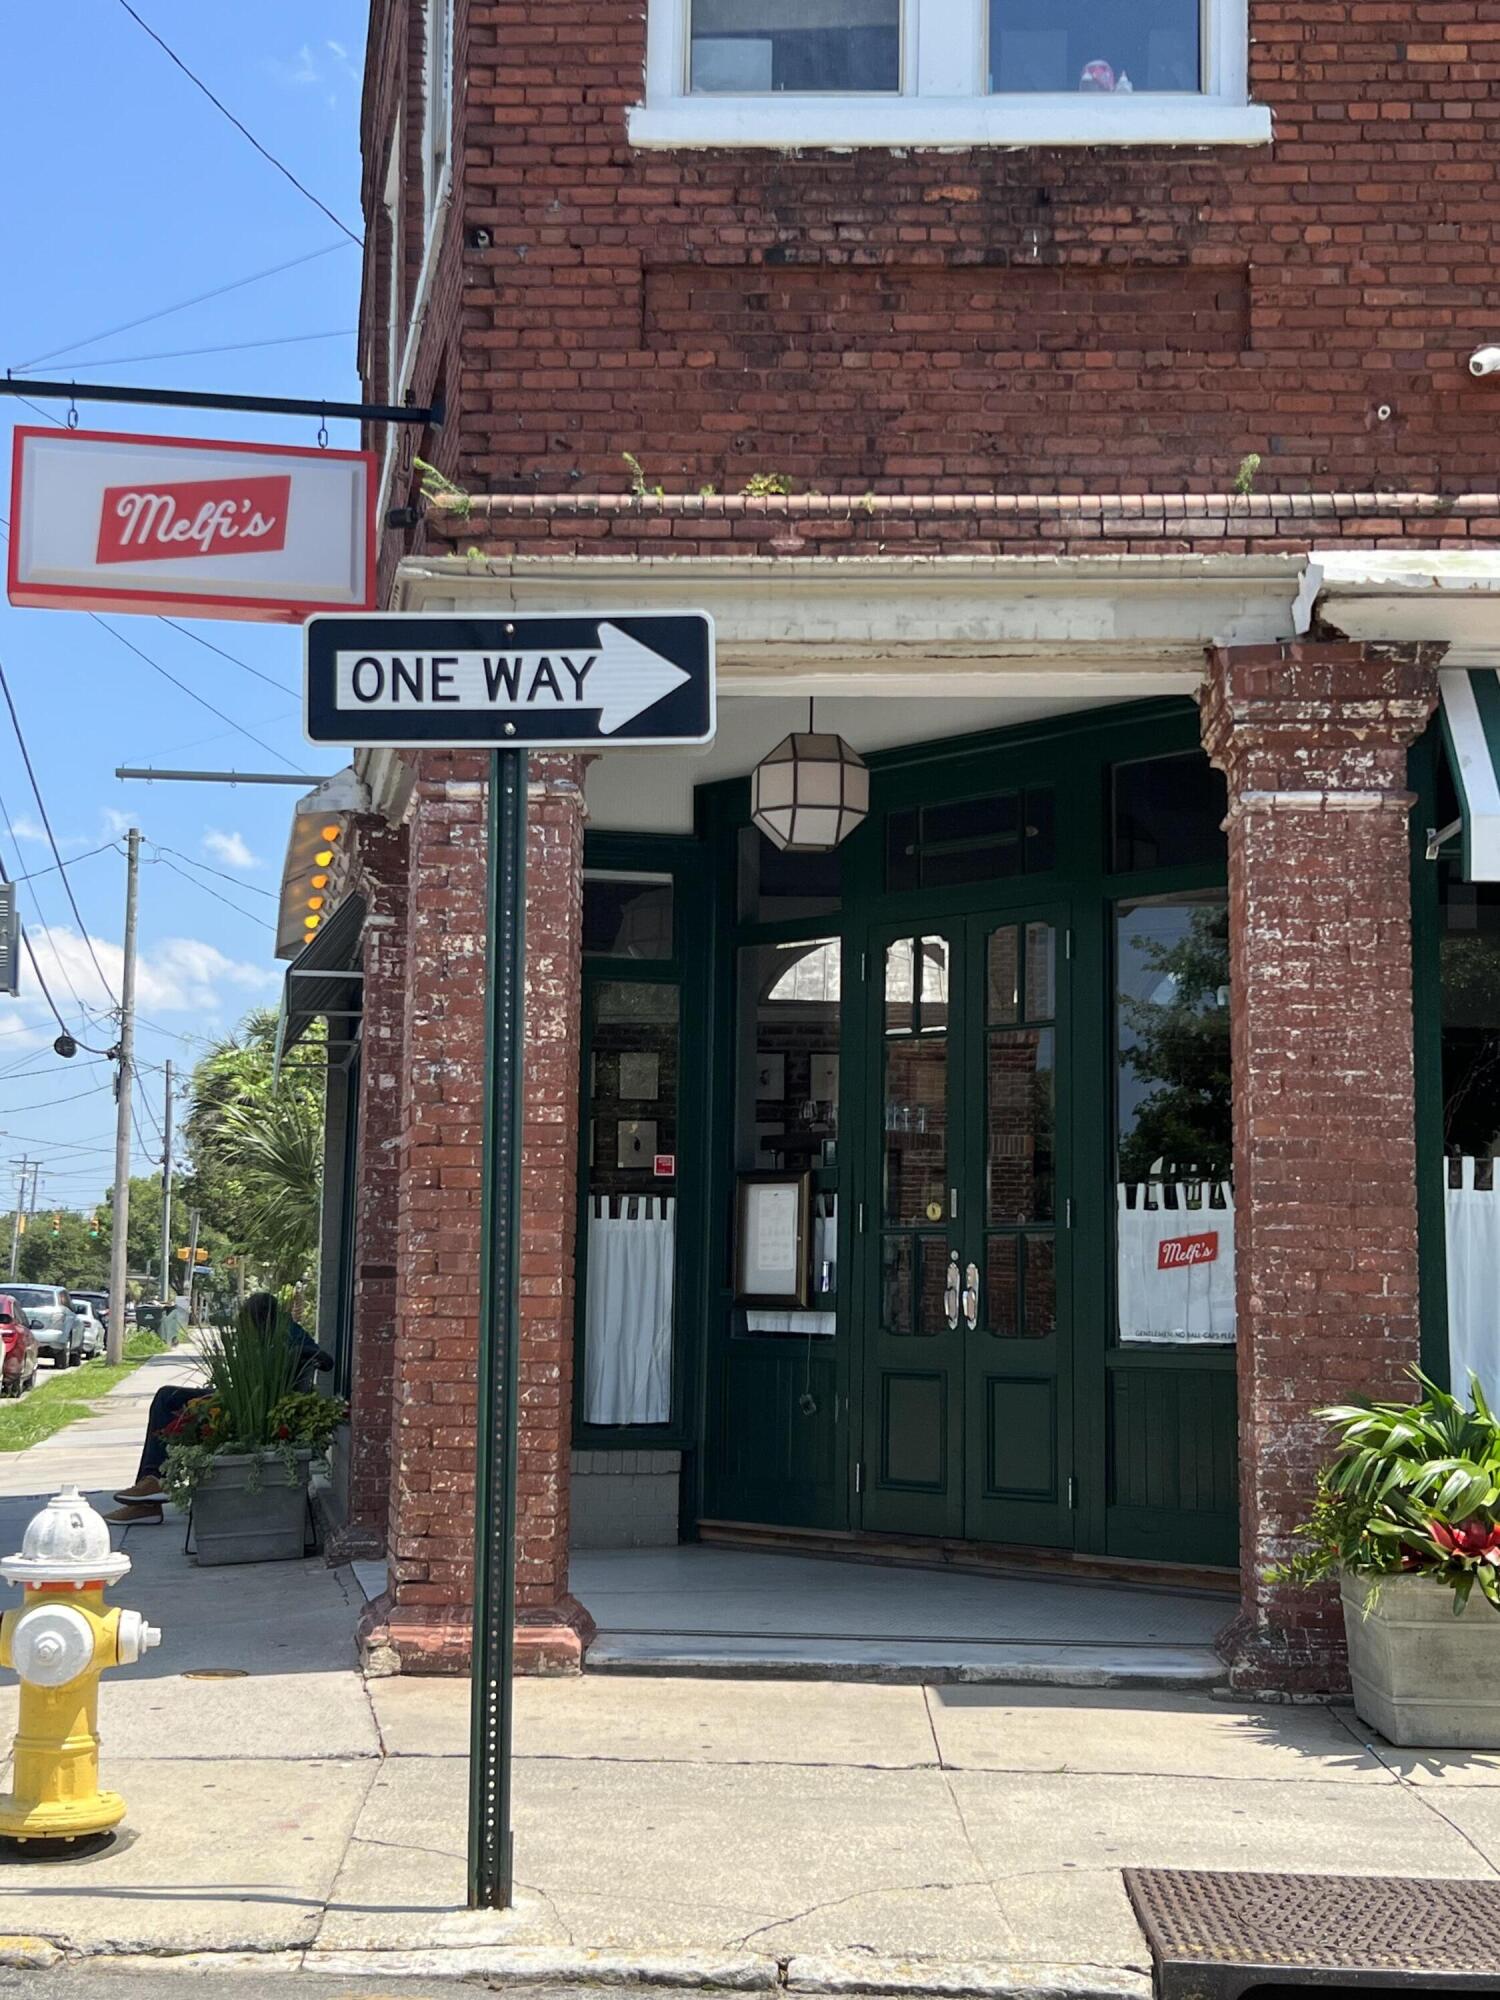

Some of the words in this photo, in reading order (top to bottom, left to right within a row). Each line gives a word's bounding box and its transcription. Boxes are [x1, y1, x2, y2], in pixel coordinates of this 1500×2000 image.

[116, 492, 276, 552] Melfi's
[352, 657, 460, 703] ONE
[483, 656, 597, 702] WAY
[1162, 1242, 1213, 1264] Melfi's
[1175, 1330, 1186, 1339] NO
